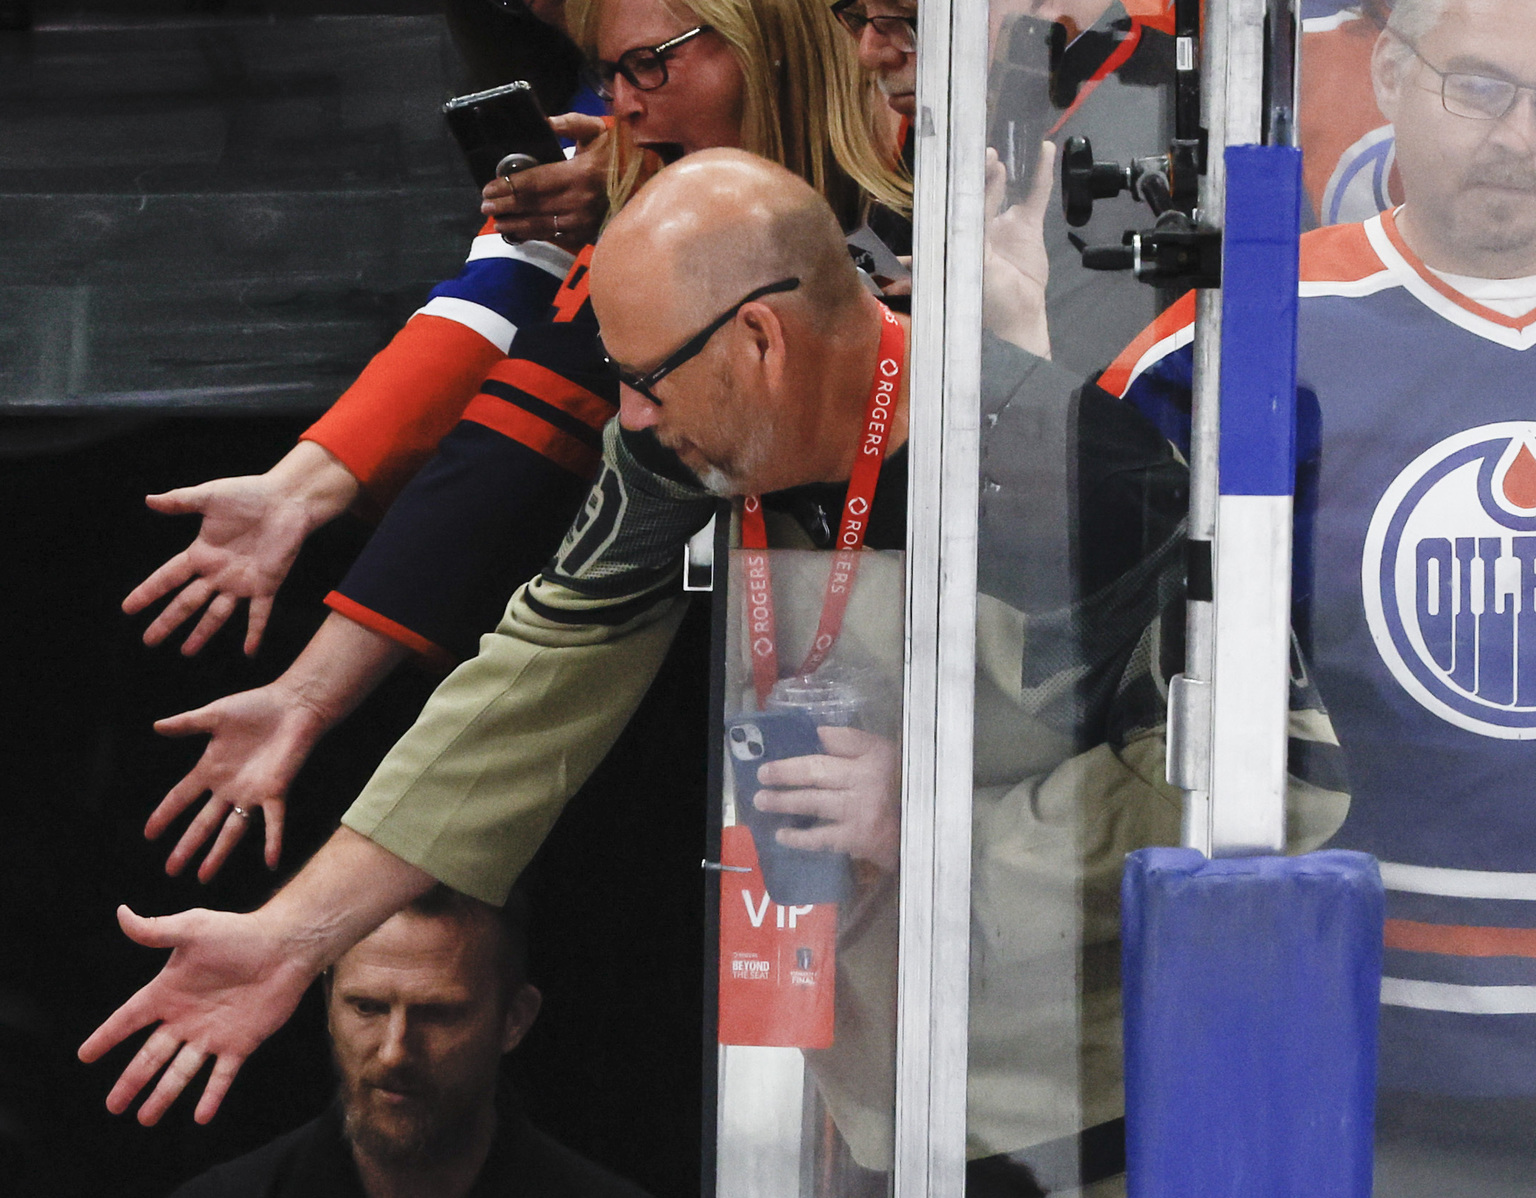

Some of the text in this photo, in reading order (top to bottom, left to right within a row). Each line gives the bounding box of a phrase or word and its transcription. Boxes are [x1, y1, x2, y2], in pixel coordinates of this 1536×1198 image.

[864, 380, 893, 456] ROGERS
[831, 520, 862, 594] ROGERS
[748, 556, 769, 633] ROGERS
[741, 889, 813, 929] VIP
[732, 961, 770, 972] BEYOND
